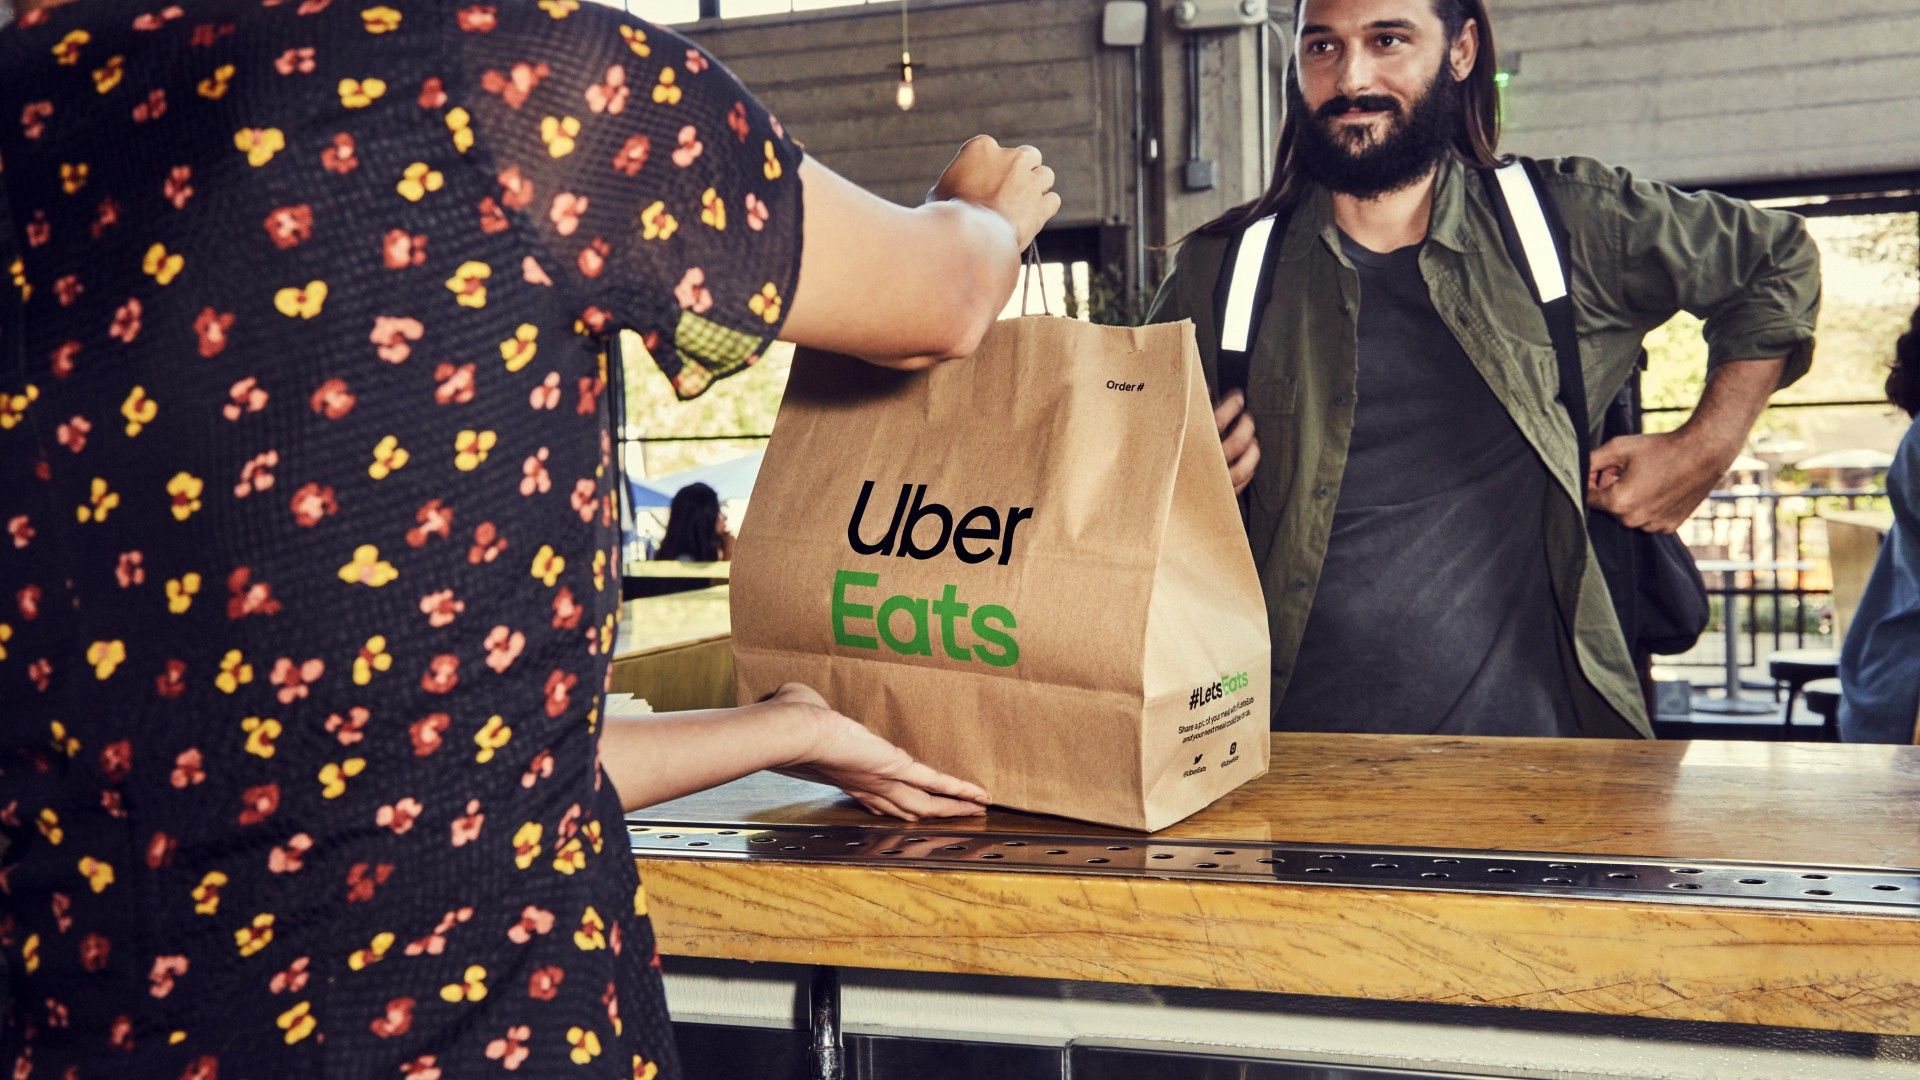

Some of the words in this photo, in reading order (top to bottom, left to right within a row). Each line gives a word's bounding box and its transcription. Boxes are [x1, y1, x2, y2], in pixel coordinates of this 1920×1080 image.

[1106, 380, 1137, 392] Order
[1136, 382, 1145, 392] #
[847, 480, 1034, 566] Uber
[832, 569, 1020, 668] Eats
[1189, 671, 1249, 710] #LetsEats
[1178, 724, 1194, 735] Share
[1205, 715, 1212, 726] of
[1210, 712, 1221, 726] your
[1182, 733, 1194, 744] and
[1191, 730, 1204, 742] your
[1203, 726, 1215, 737] next
[1214, 720, 1227, 733] meal
